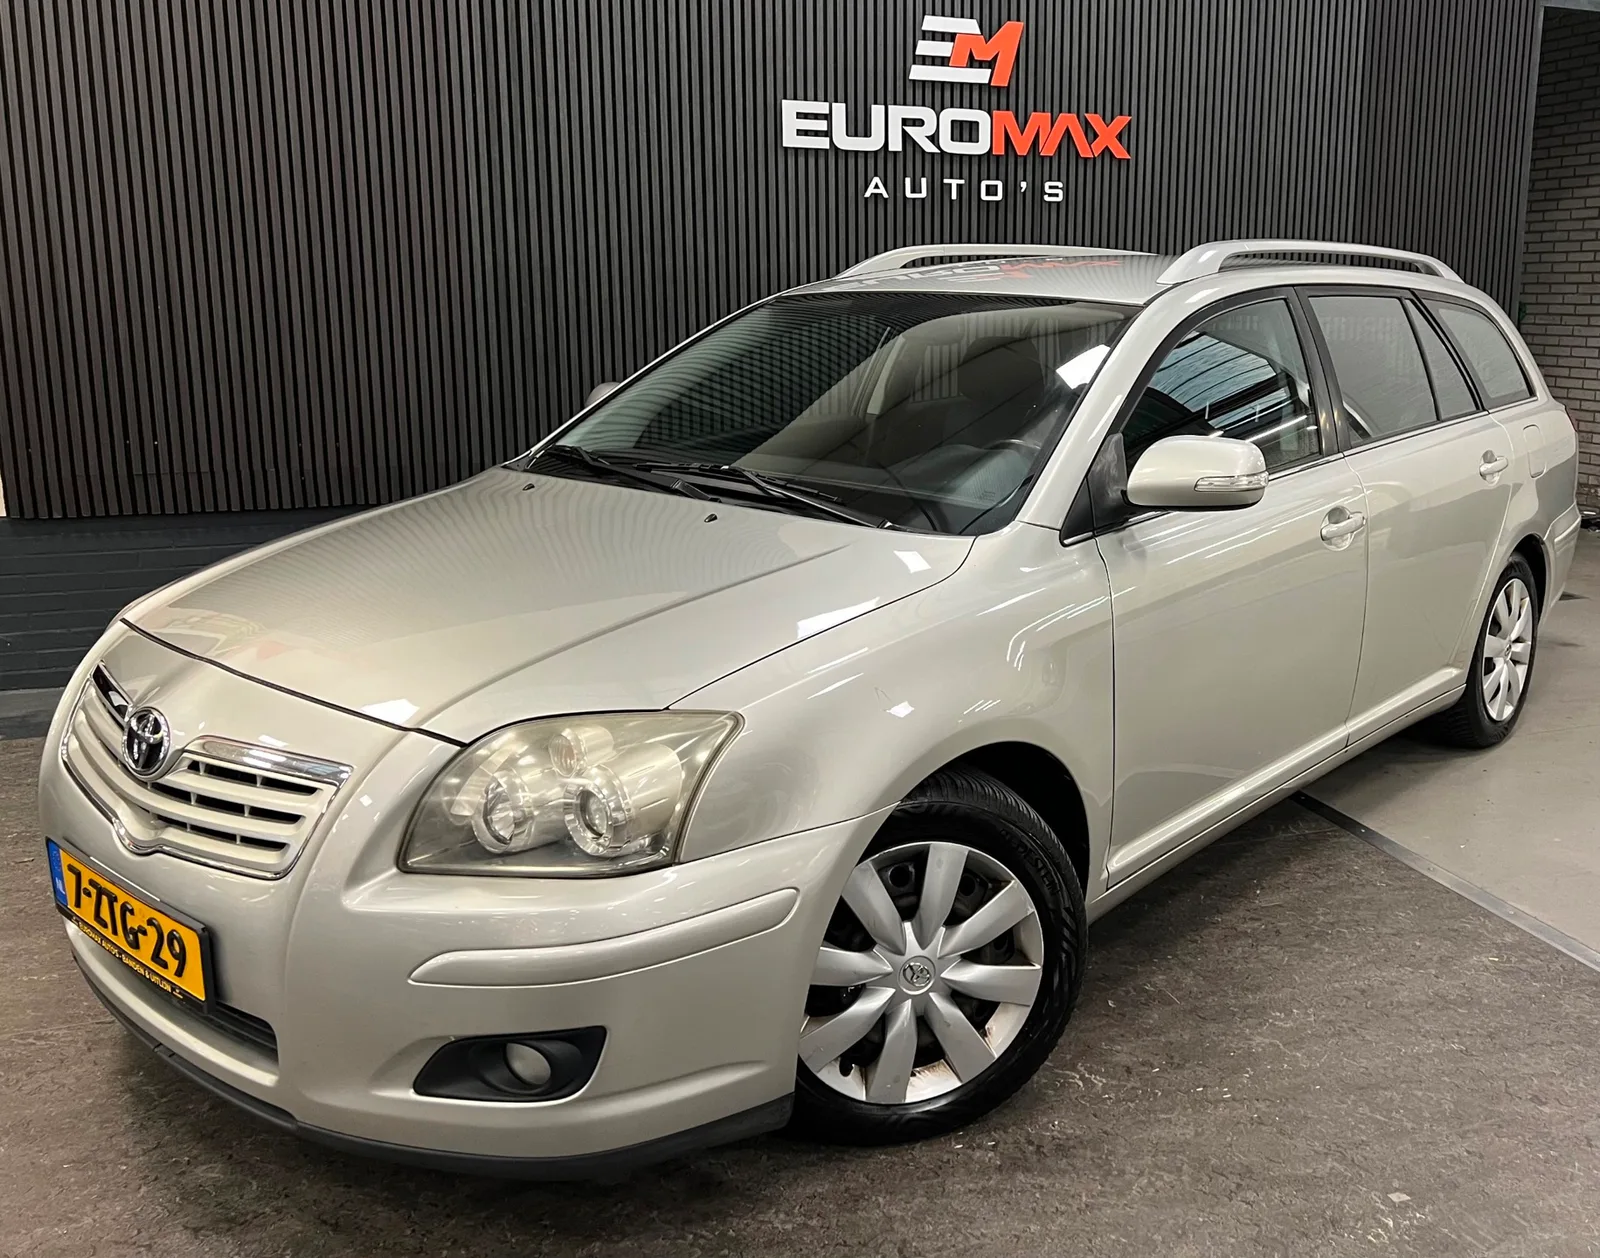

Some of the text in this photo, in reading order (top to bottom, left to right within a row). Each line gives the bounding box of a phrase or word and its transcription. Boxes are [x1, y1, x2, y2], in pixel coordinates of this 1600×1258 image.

[781, 99, 1132, 160] EUROMAX
[864, 176, 1064, 202] AUTO'S
[55, 876, 66, 895] NL
[67, 863, 187, 978] 7-ZTG-29
